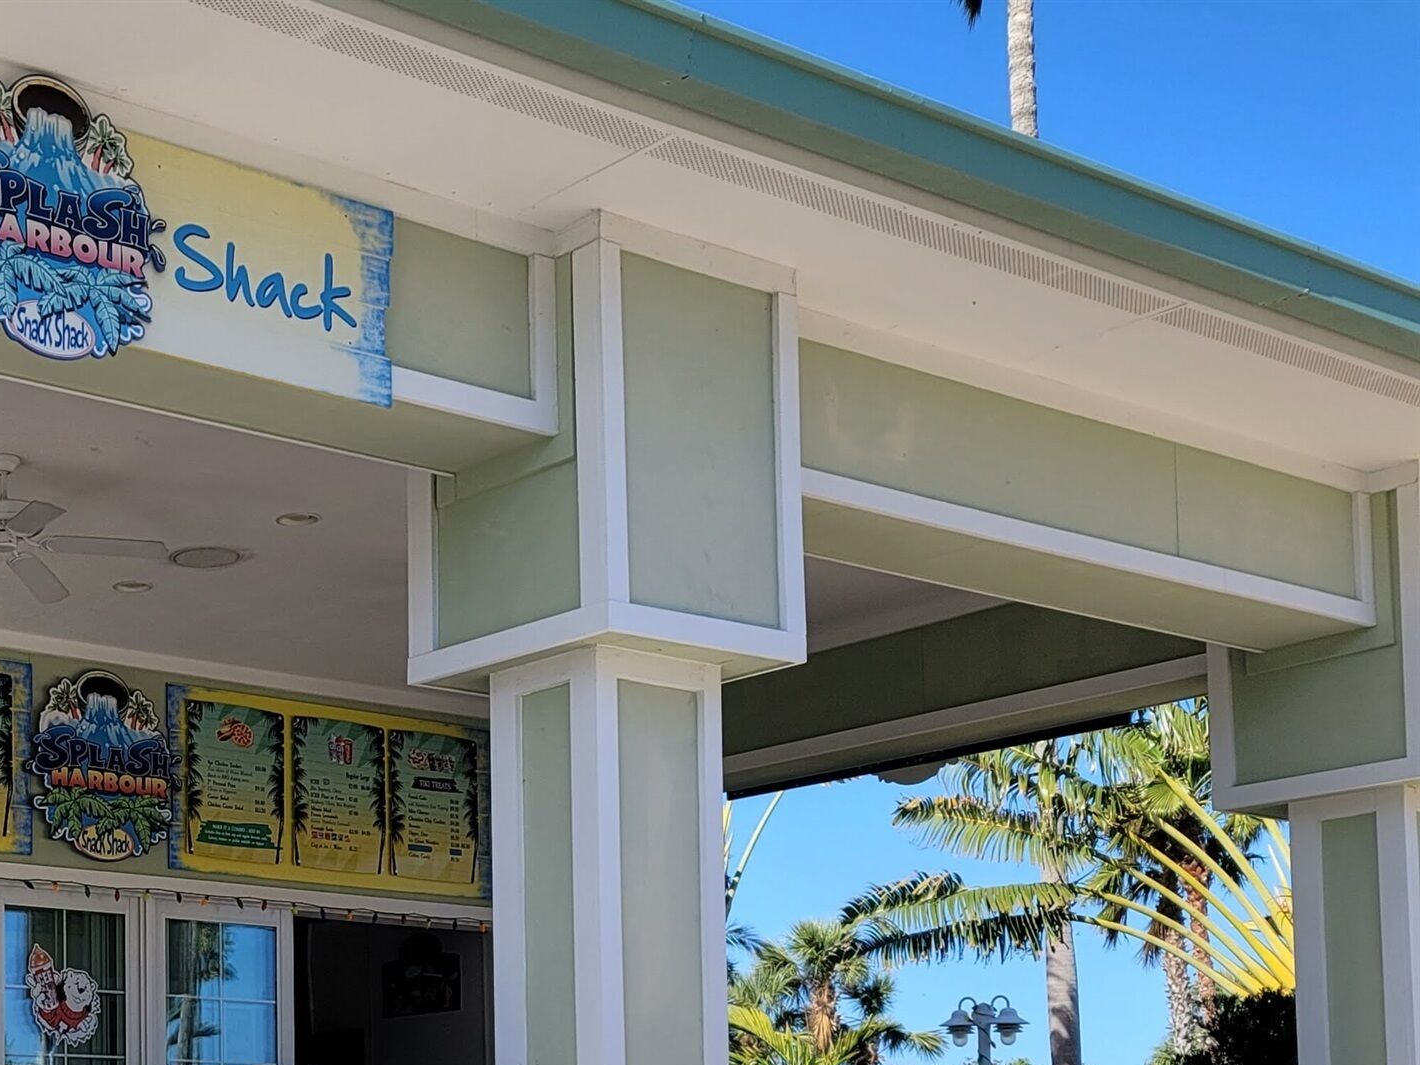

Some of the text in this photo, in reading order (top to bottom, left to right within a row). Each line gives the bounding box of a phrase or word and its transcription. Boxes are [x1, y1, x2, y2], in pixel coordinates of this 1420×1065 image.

[173, 224, 358, 332] Shack
[17, 307, 89, 351] Snack Shack
[35, 724, 170, 779] SPLASH
[51, 767, 167, 799] HARBOUR
[82, 830, 129, 855] Snack Shack
